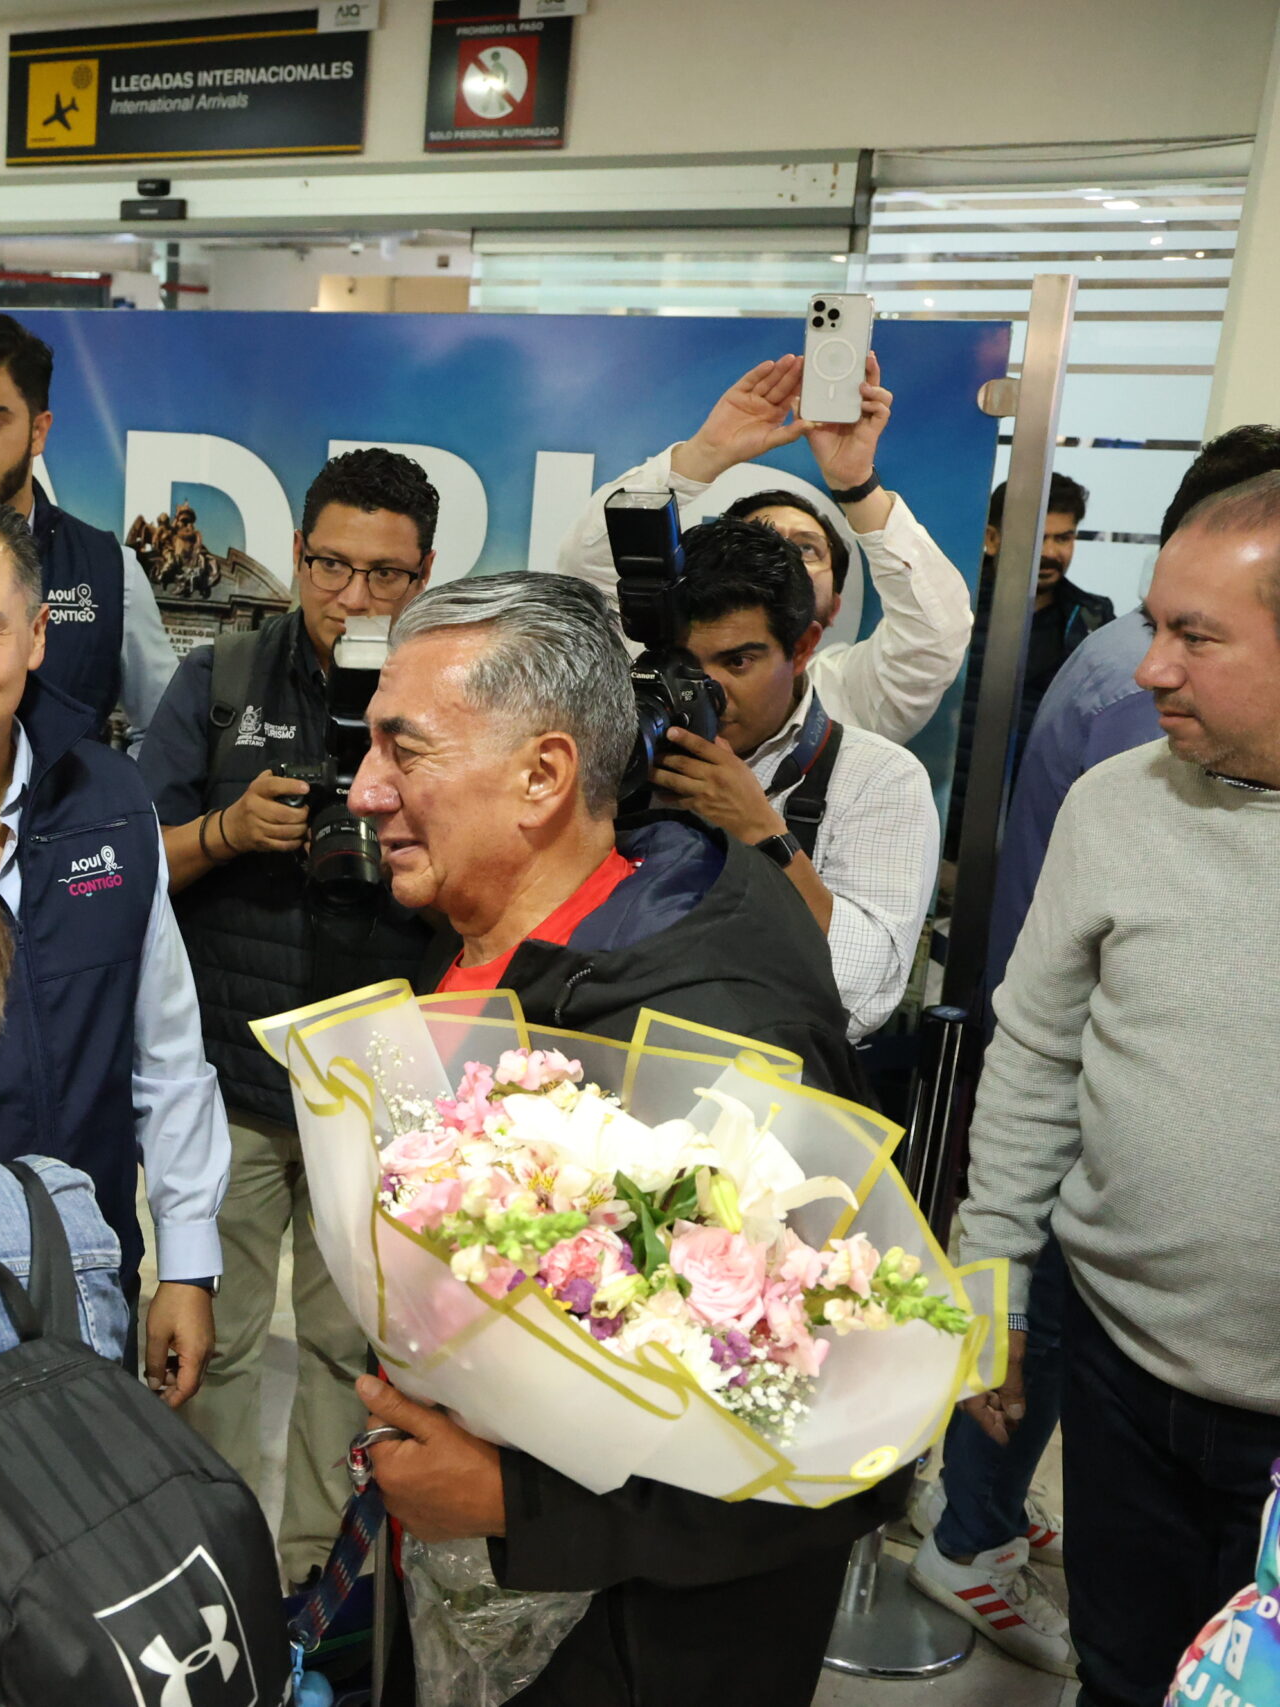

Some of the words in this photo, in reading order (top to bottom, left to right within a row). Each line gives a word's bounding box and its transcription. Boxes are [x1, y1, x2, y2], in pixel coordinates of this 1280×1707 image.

[111, 71, 194, 93] LLEGADAS
[197, 60, 354, 88] INTERNACIONALES
[109, 94, 196, 115] International
[195, 91, 249, 111] Arrivals
[47, 588, 77, 602] AQUÍ
[47, 608, 96, 623] ONTIGO
[630, 671, 656, 680] Canon
[70, 853, 103, 873] AQUÍ
[68, 873, 124, 896] CONTIGO
